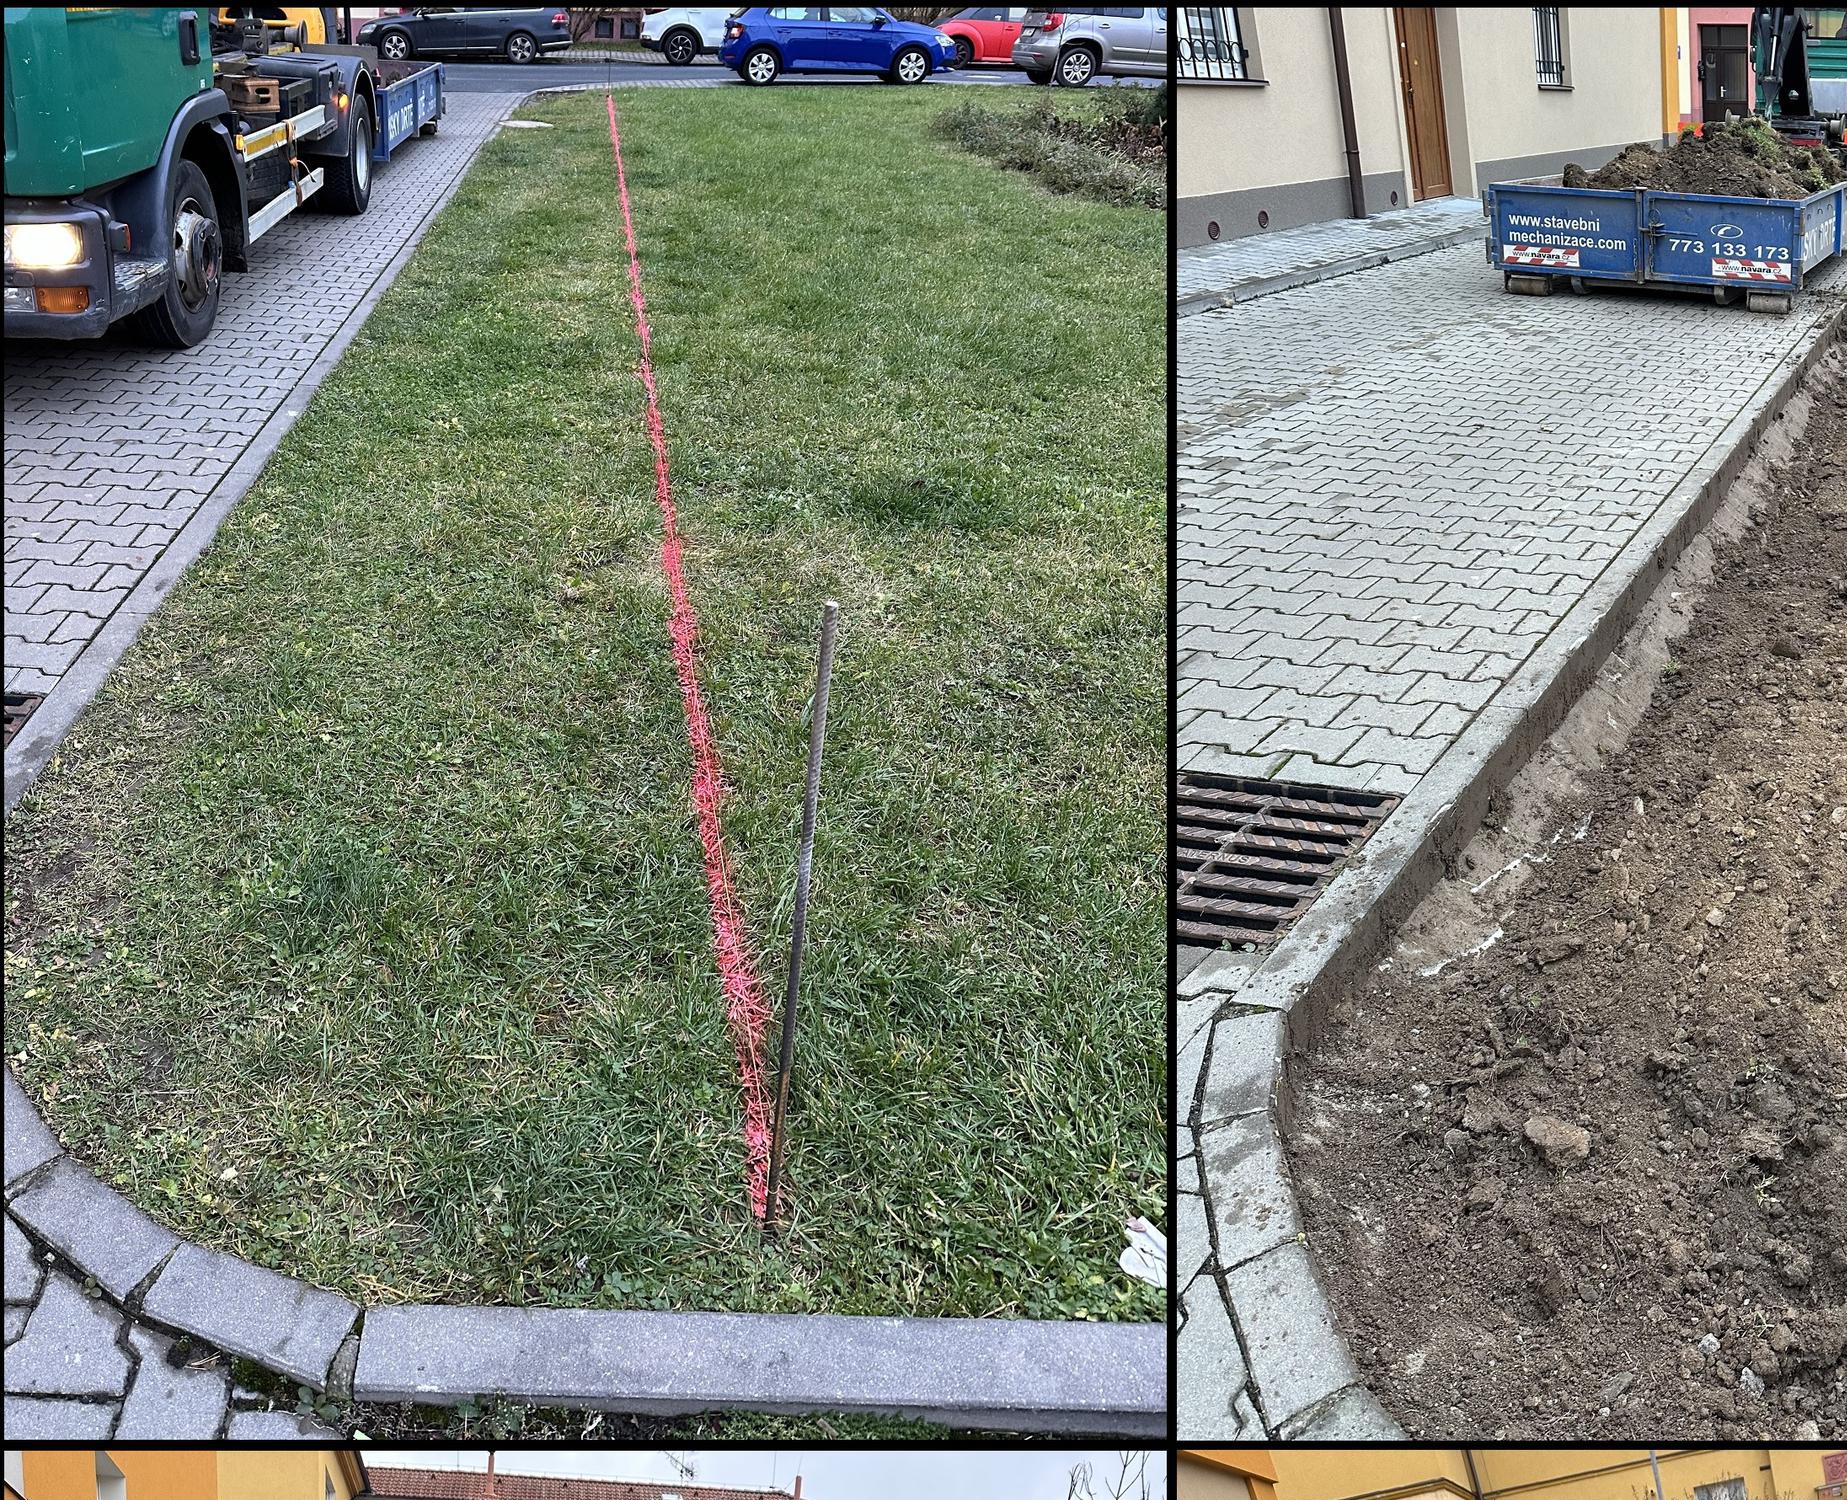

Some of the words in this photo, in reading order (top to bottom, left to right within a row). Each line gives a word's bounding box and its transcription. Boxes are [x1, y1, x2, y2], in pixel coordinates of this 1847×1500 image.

[1508, 214, 1600, 232] www.stavebni
[1509, 230, 1627, 251] mechanizace.com
[1669, 238, 1705, 254] 773
[1712, 242, 1747, 257] 133
[1754, 245, 1790, 260] 173
